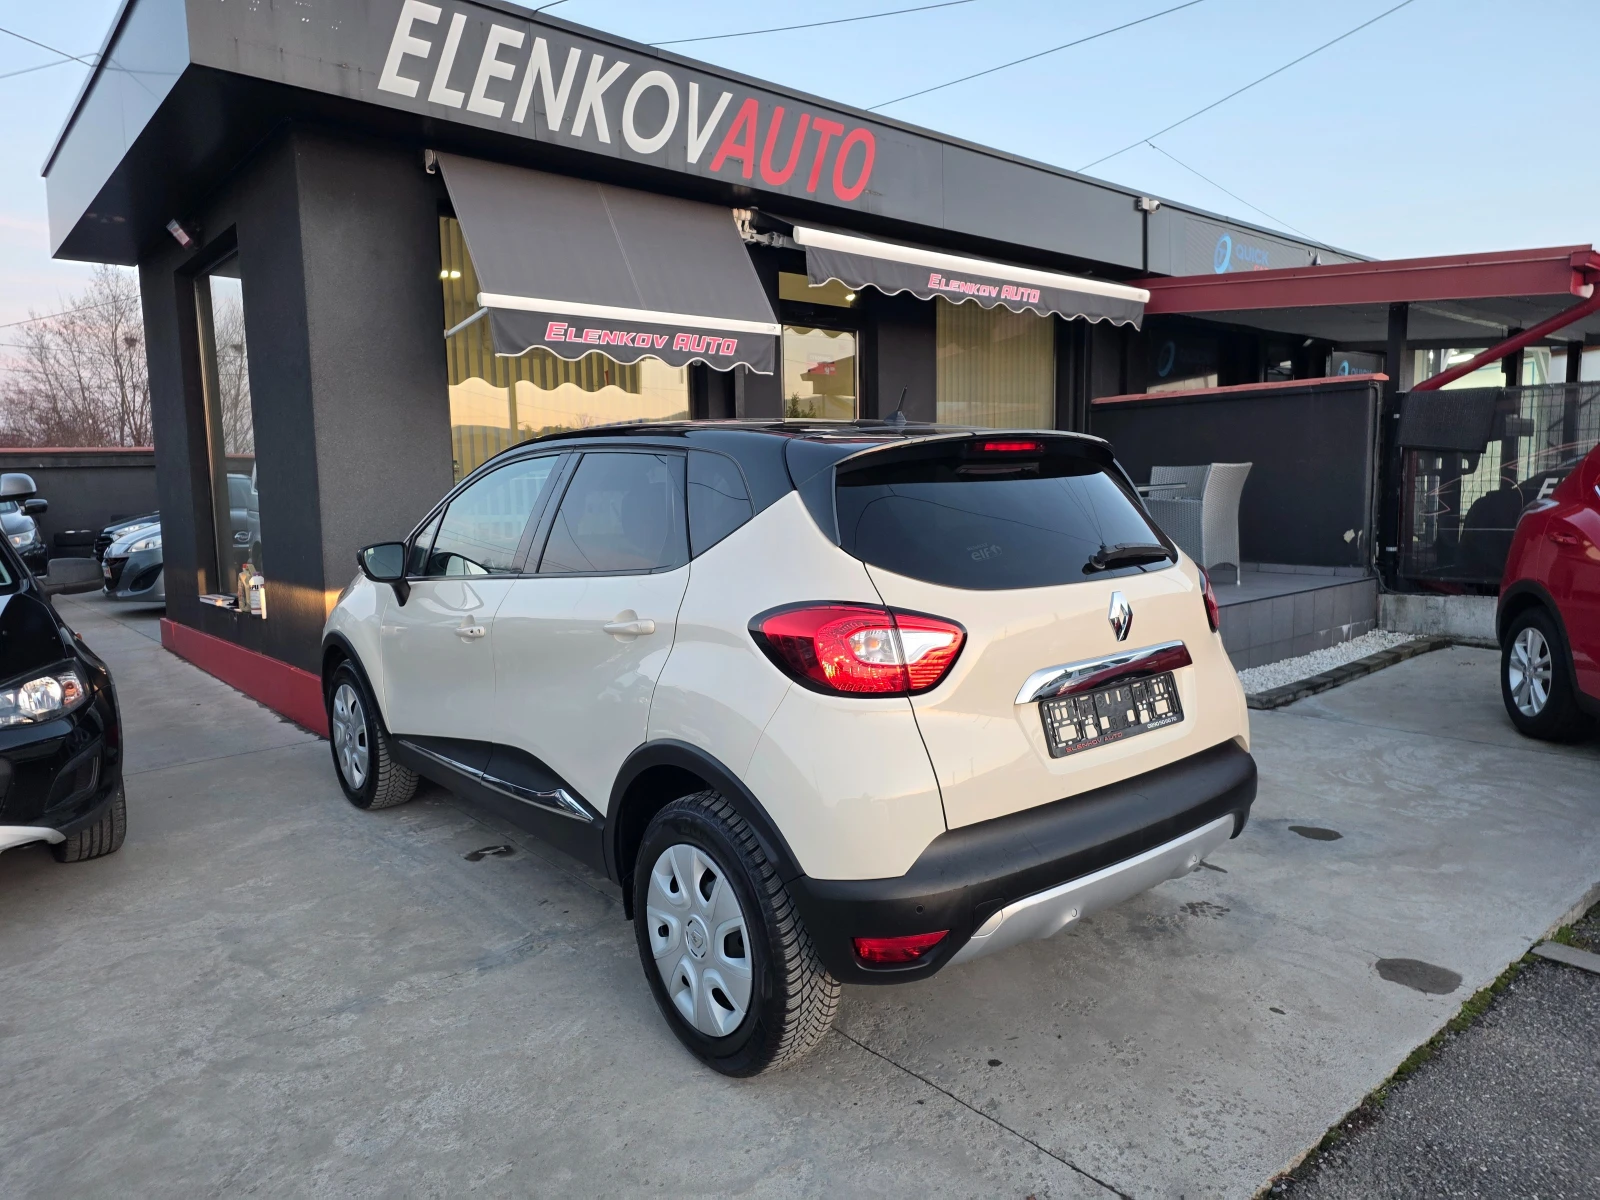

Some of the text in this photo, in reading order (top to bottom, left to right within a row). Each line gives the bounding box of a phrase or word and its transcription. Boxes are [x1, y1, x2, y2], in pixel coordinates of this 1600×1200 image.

[1235, 243, 1269, 266] QUICK
[928, 272, 1040, 304] ELENKOV AUTO
[544, 321, 738, 356] ELENKOV AUTO
[1104, 731, 1123, 742] AUTO
